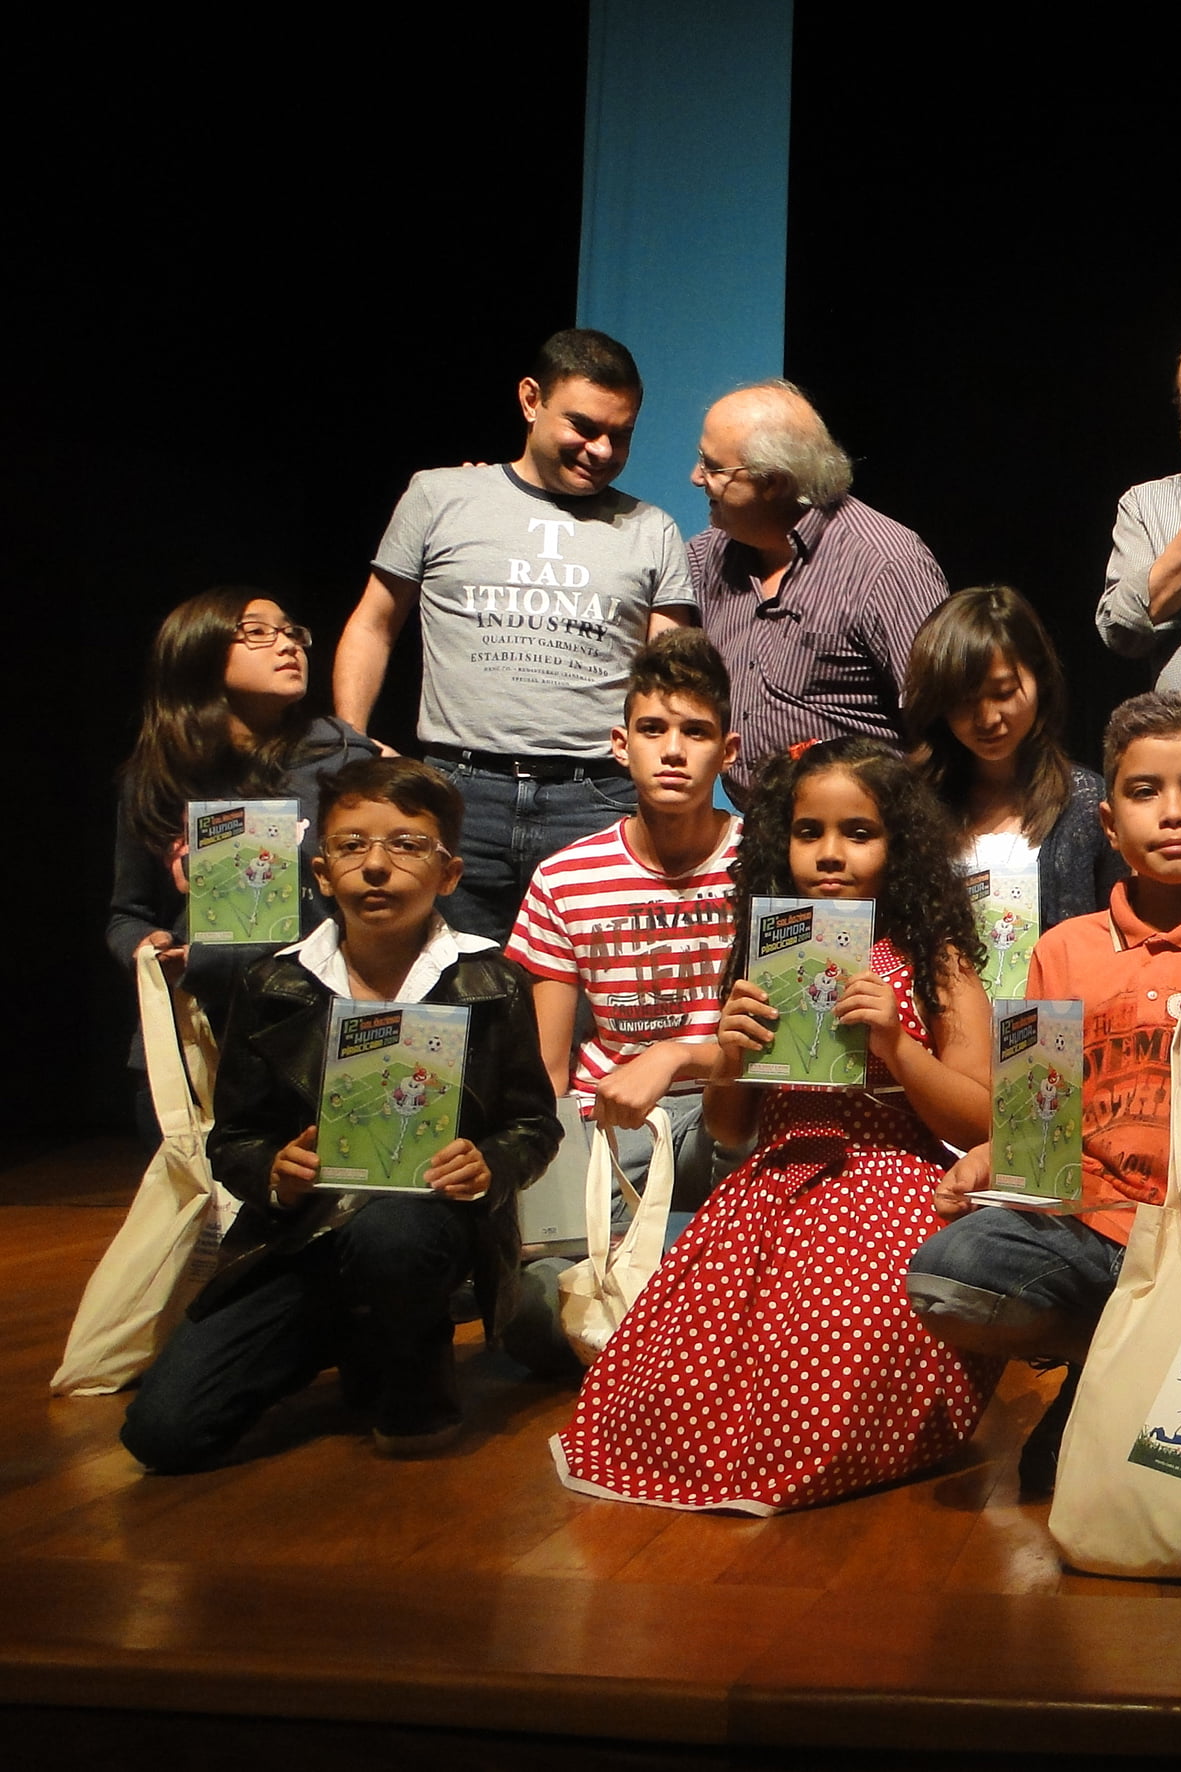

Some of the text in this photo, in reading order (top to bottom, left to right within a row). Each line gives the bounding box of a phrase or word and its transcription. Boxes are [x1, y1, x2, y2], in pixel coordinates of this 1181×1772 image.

[508, 558, 590, 588] RAD
[477, 611, 608, 642] INDUSTRY
[482, 634, 600, 658] QUALITY GARMENTS
[471, 652, 562, 666] ESTABLISHED
[568, 659, 582, 670] IN
[772, 922, 806, 942] HUMOR
